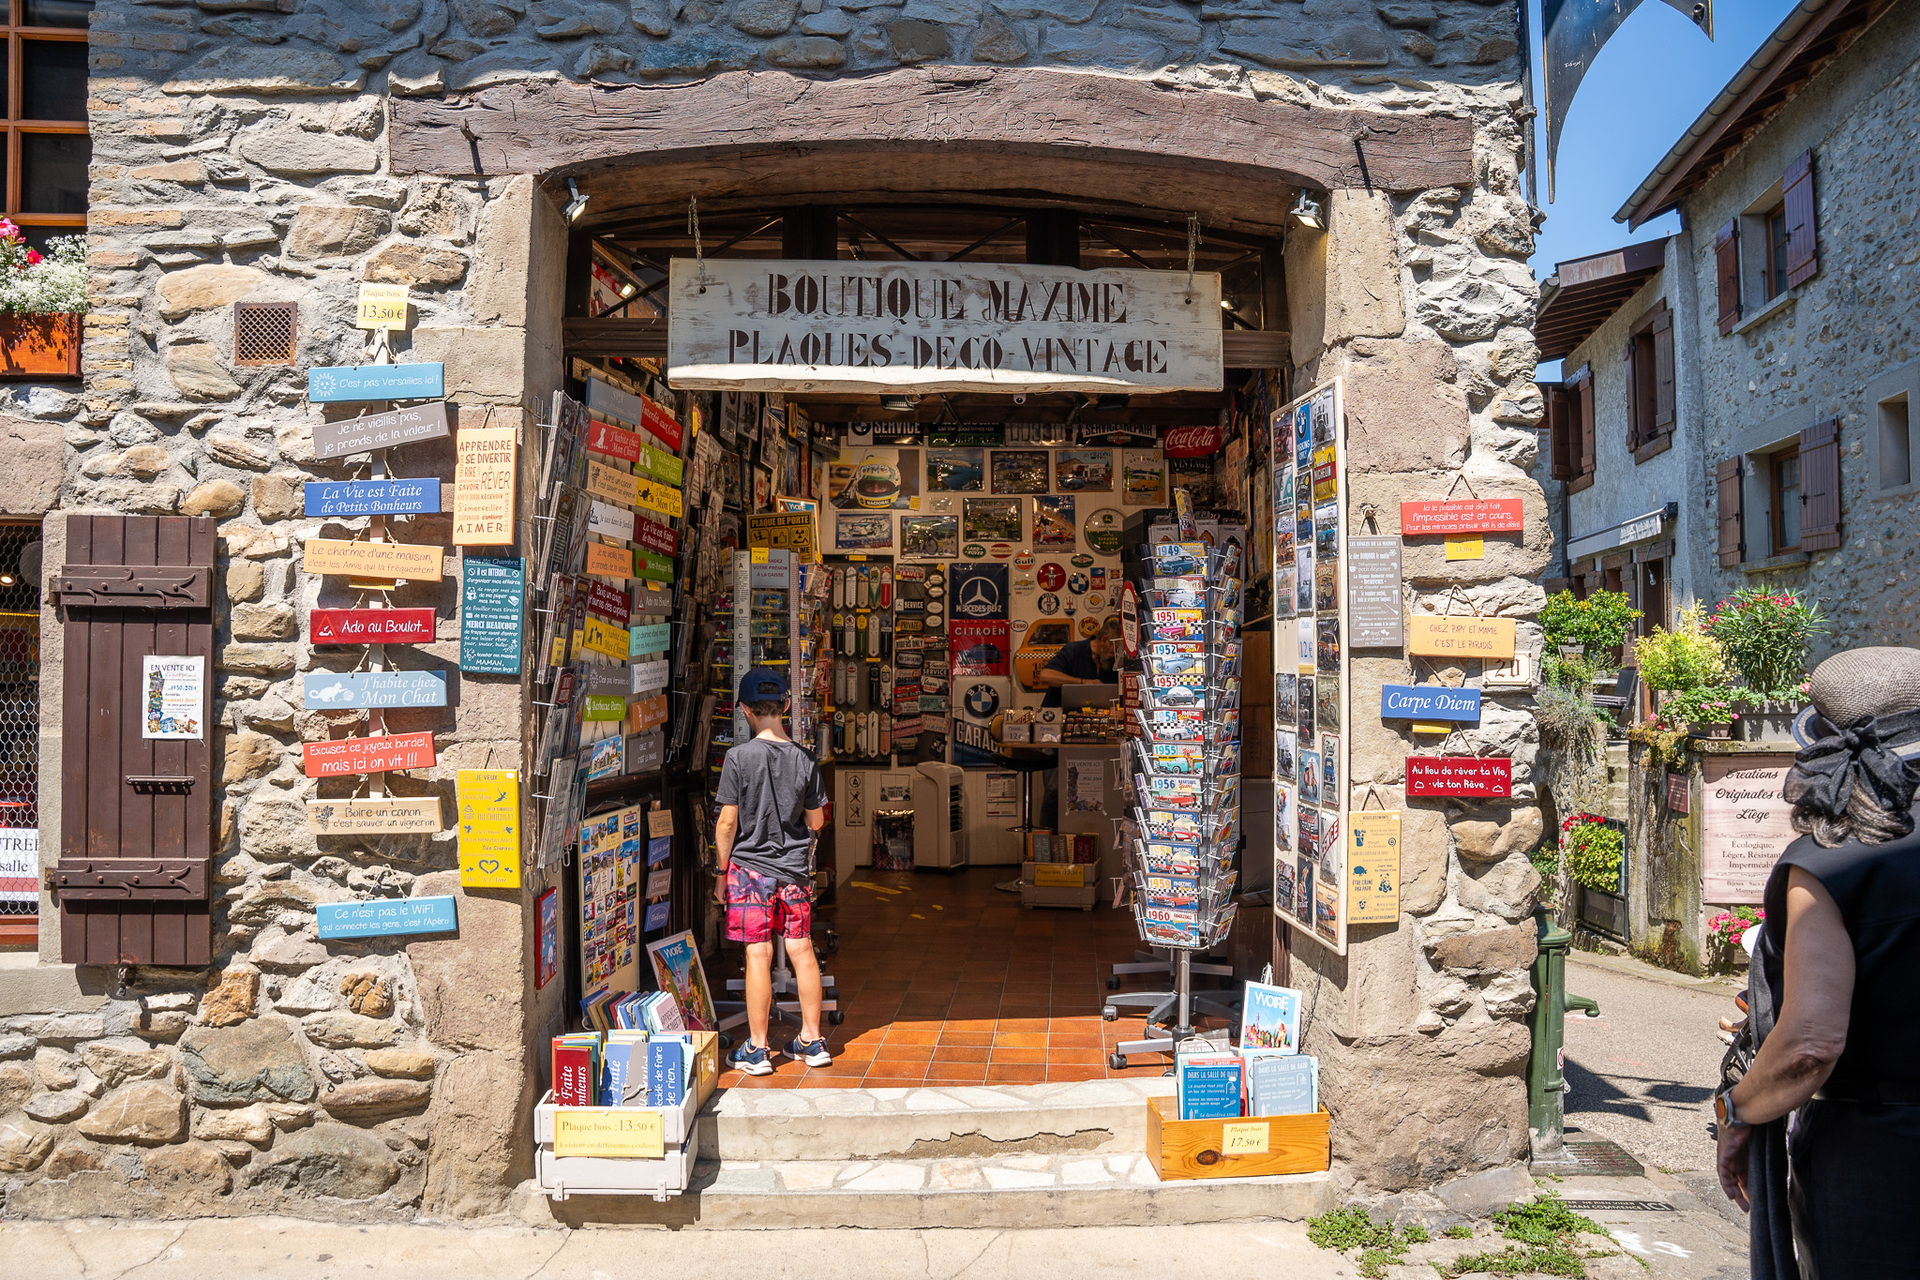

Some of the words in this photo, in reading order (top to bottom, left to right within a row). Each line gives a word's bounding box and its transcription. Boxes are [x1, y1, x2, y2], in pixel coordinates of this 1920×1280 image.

[768, 273, 965, 324] BOUTIQUE
[989, 280, 1127, 324] MAXIME
[1021, 338, 1169, 374] VINTAGE
[340, 378, 361, 388] C'est
[364, 378, 380, 389] pas
[382, 376, 423, 386] Versailles
[425, 376, 434, 384] ici
[337, 424, 350, 435] Je
[352, 420, 365, 431] ne
[368, 414, 397, 429] vieillis
[400, 413, 421, 427] pas,
[323, 442, 335, 456] je
[337, 437, 373, 453] prends
[375, 432, 388, 442] de
[391, 429, 401, 440] la
[403, 424, 434, 437] valeur
[1165, 426, 1216, 450] Coca-Cola
[459, 440, 512, 452] APPRENDRE
[465, 453, 476, 464] SE
[478, 453, 511, 464] DIVERTIR
[481, 465, 511, 490] RÊVER
[322, 488, 340, 500] La
[343, 485, 366, 498] Vie
[368, 487, 386, 498] est
[388, 485, 423, 497] Faite
[321, 501, 334, 513] de
[337, 500, 368, 512] Petits
[371, 500, 423, 511] Bonheurs
[1439, 504, 1463, 512] possible
[1461, 512, 1474, 520] est
[456, 522, 503, 533] AIMER
[1406, 523, 1420, 531] Pour
[1459, 523, 1480, 531] prévoir
[312, 546, 325, 555] Le
[327, 548, 366, 557] charme
[368, 550, 395, 559] d'une
[397, 552, 434, 564] maison,
[1157, 546, 1179, 556] 1949
[308, 559, 327, 567] c'est
[329, 560, 341, 568] les
[343, 561, 362, 569] Amis
[364, 563, 376, 573] qui
[378, 564, 385, 572] la
[388, 563, 435, 575] fréquentent
[1157, 612, 1177, 622] 1951
[341, 619, 364, 634] Ado
[368, 623, 383, 632] au
[385, 620, 430, 634] Boulot...
[466, 620, 485, 629] MERCI
[486, 621, 518, 630] BEAUCOUP
[955, 627, 1005, 636] CITROËN
[1430, 623, 1448, 633] CHEZ
[1469, 624, 1476, 634] ET
[1478, 625, 1498, 635] MAMIE
[1155, 644, 1176, 655] 1952
[1435, 638, 1454, 648] C'EST
[1458, 639, 1467, 648] LE
[1468, 640, 1493, 649] PARADIS
[1494, 659, 1520, 678] 20
[362, 676, 410, 691] J'habite
[412, 677, 437, 688] chez
[1156, 676, 1177, 687] 1953
[361, 691, 399, 705] Mon
[402, 690, 437, 705] Chat
[1388, 692, 1431, 714] Carpe
[1435, 695, 1476, 711] Diem
[310, 745, 347, 756] Excusez
[350, 744, 361, 752] ce
[362, 741, 393, 754] joyeux
[395, 737, 429, 749] bordel,
[1155, 746, 1176, 755] 1955
[322, 759, 349, 772] mais
[353, 758, 366, 770] ici
[370, 758, 385, 768] on
[388, 754, 403, 766] vit
[407, 753, 418, 765] !!!
[1412, 765, 1423, 775] Au
[1425, 765, 1439, 775] lieu
[1442, 766, 1452, 775] de
[1454, 766, 1477, 776] rêver
[1480, 767, 1491, 776] ta
[1493, 766, 1508, 778] Vie,
[1726, 768, 1778, 779] Créations
[1153, 779, 1176, 790] 1956
[1432, 779, 1445, 789] vis
[1447, 779, 1462, 789] ton
[1716, 788, 1773, 803] Originales
[345, 807, 373, 817] Boire
[377, 809, 388, 817] un
[392, 809, 421, 817] canon
[1736, 808, 1770, 823] Liège
[333, 818, 353, 827] c'est
[356, 819, 383, 827] sauver
[388, 819, 398, 827] un
[400, 818, 435, 828] vigneron
[1149, 879, 1171, 889] 1959
[335, 908, 349, 919] Ce
[352, 907, 375, 918] n'est
[378, 908, 397, 921] pas
[400, 906, 409, 915] le
[411, 904, 435, 914] WiFi
[1148, 910, 1170, 922] 1960
[322, 924, 333, 934] qui
[335, 921, 368, 931] connecte
[370, 920, 381, 929] les
[382, 920, 402, 930] gens,
[404, 918, 422, 927] c'est
